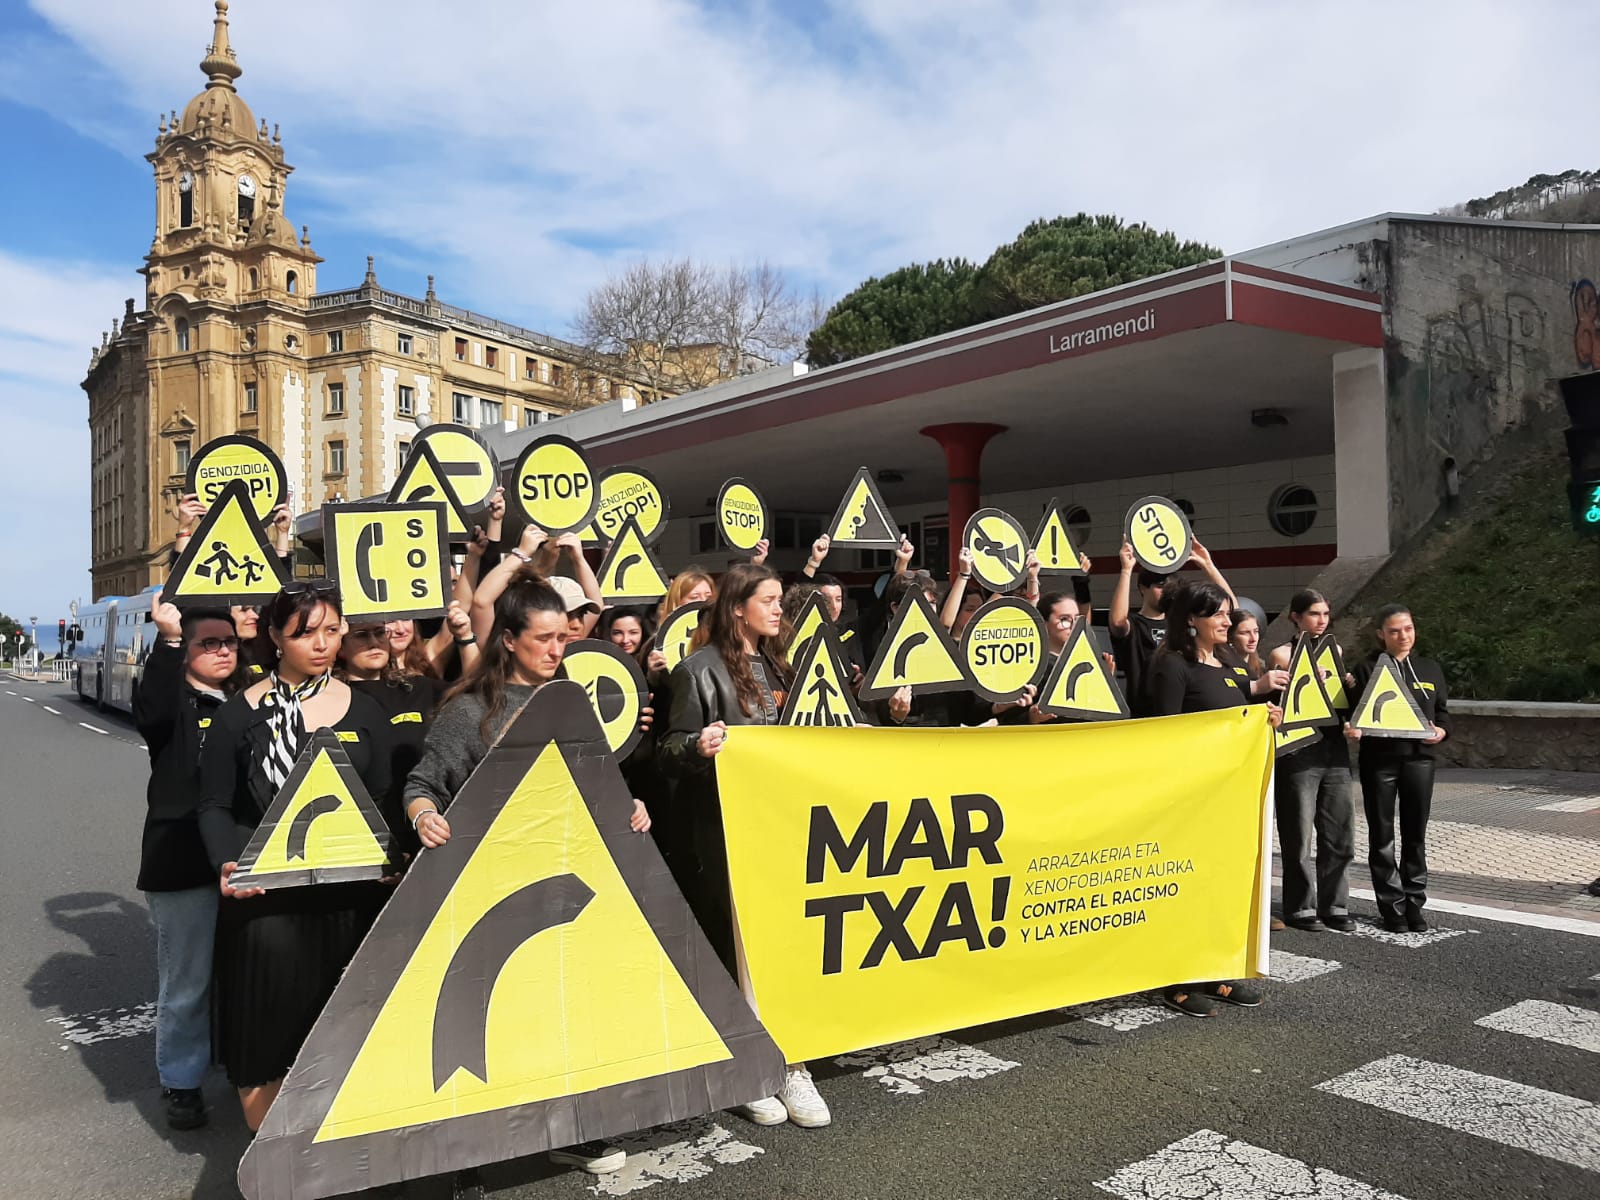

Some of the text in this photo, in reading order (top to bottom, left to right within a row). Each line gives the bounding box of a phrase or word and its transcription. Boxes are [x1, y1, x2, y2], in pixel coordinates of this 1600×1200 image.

[1049, 308, 1155, 354] Larramendi
[200, 463, 270, 478] GENOZIDIOA
[522, 472, 589, 501] STOP
[602, 491, 657, 529] STOP!
[725, 510, 761, 532] STOP!
[1139, 506, 1177, 561] STOP
[974, 627, 1034, 641] GENOZIDIOA
[975, 642, 1034, 666] STOP!
[806, 793, 1004, 884] MAR
[1026, 842, 1160, 874] ARRAZAKERIA ETA
[1024, 859, 1194, 897] XENOFOBIAREN AURKA
[1021, 882, 1179, 920] CONTRA EL RACISMO
[805, 875, 1011, 975] TXA!
[1020, 909, 1146, 943] Y LA XENOFOBIA
